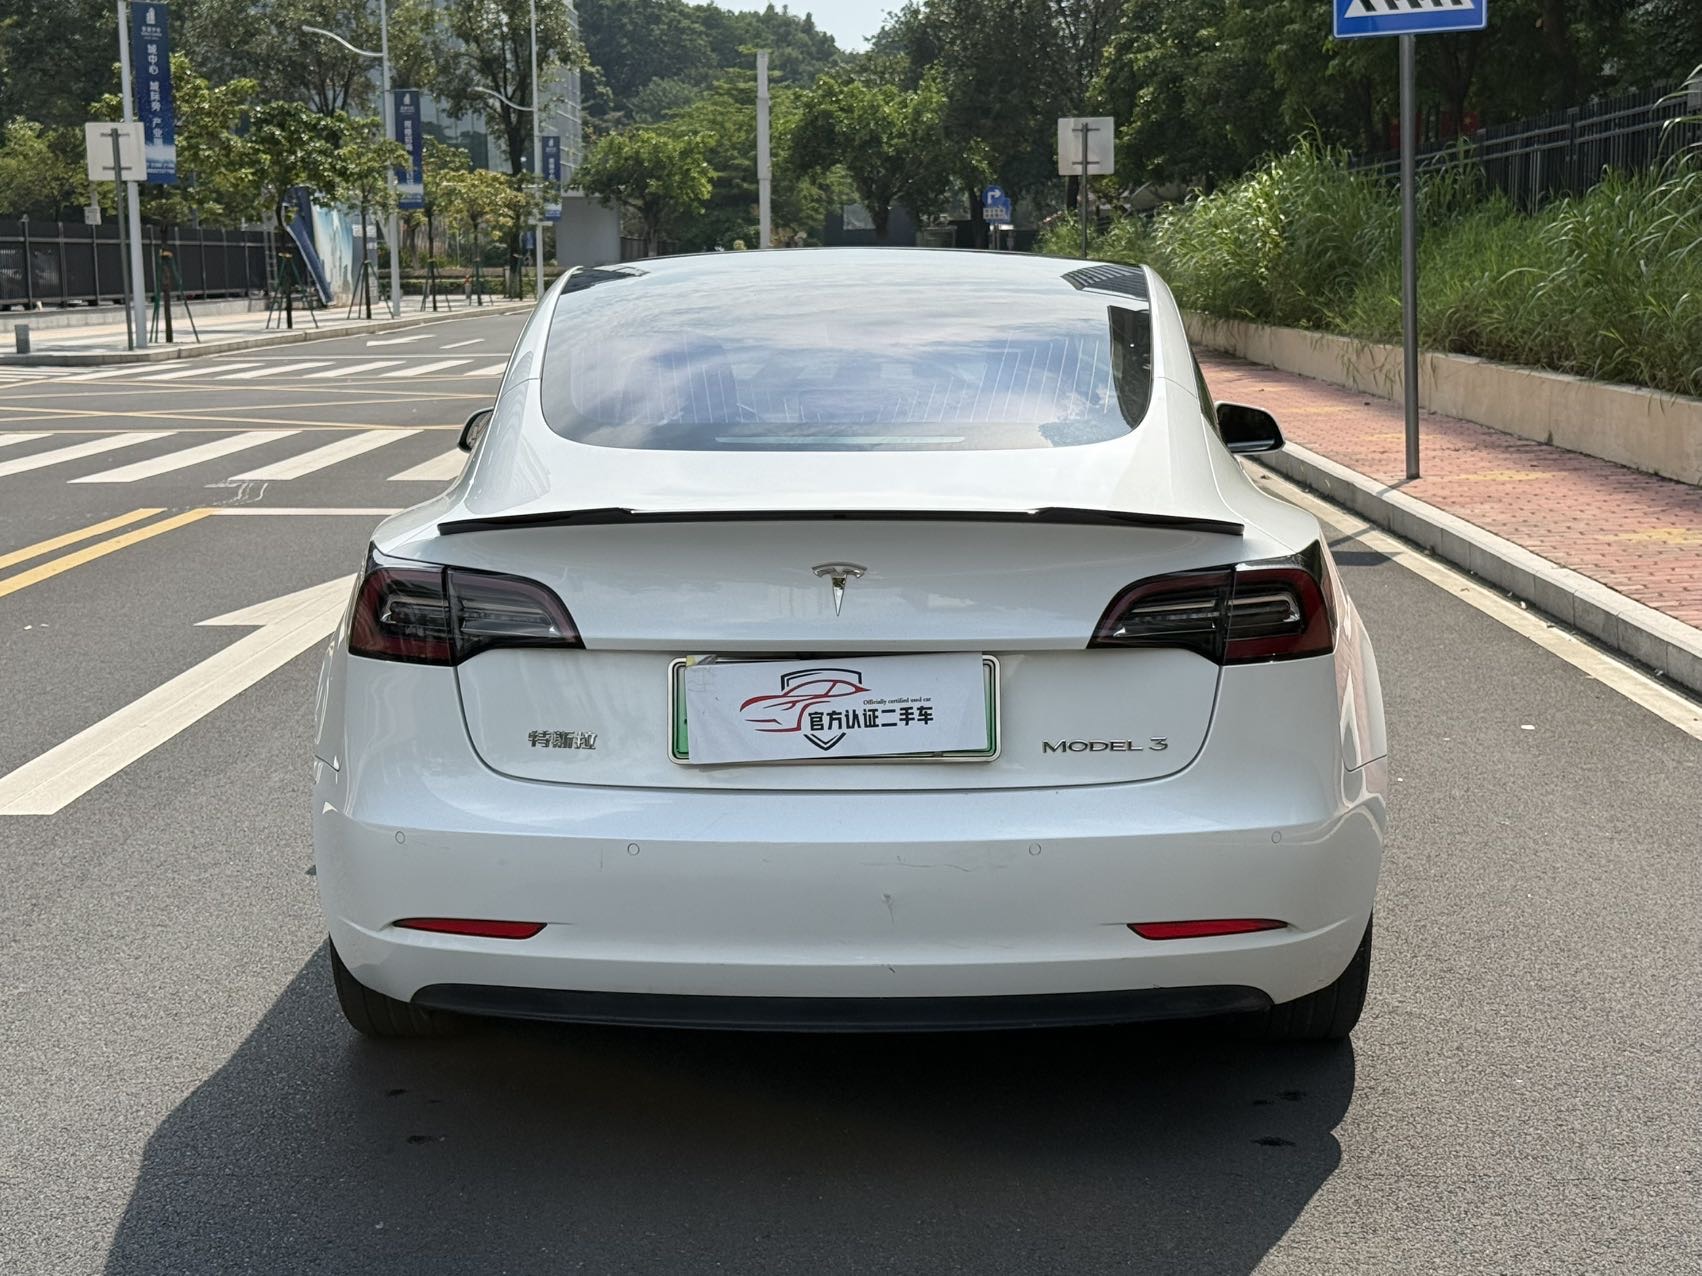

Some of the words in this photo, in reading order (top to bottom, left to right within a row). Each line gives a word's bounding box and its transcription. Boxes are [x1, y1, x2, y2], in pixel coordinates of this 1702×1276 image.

[863, 698, 887, 706] Officially
[808, 705, 934, 731] 官方认证二手车
[527, 730, 598, 750] 特斯拉
[1042, 739, 1144, 753] MODEL
[1149, 736, 1169, 751] 3
